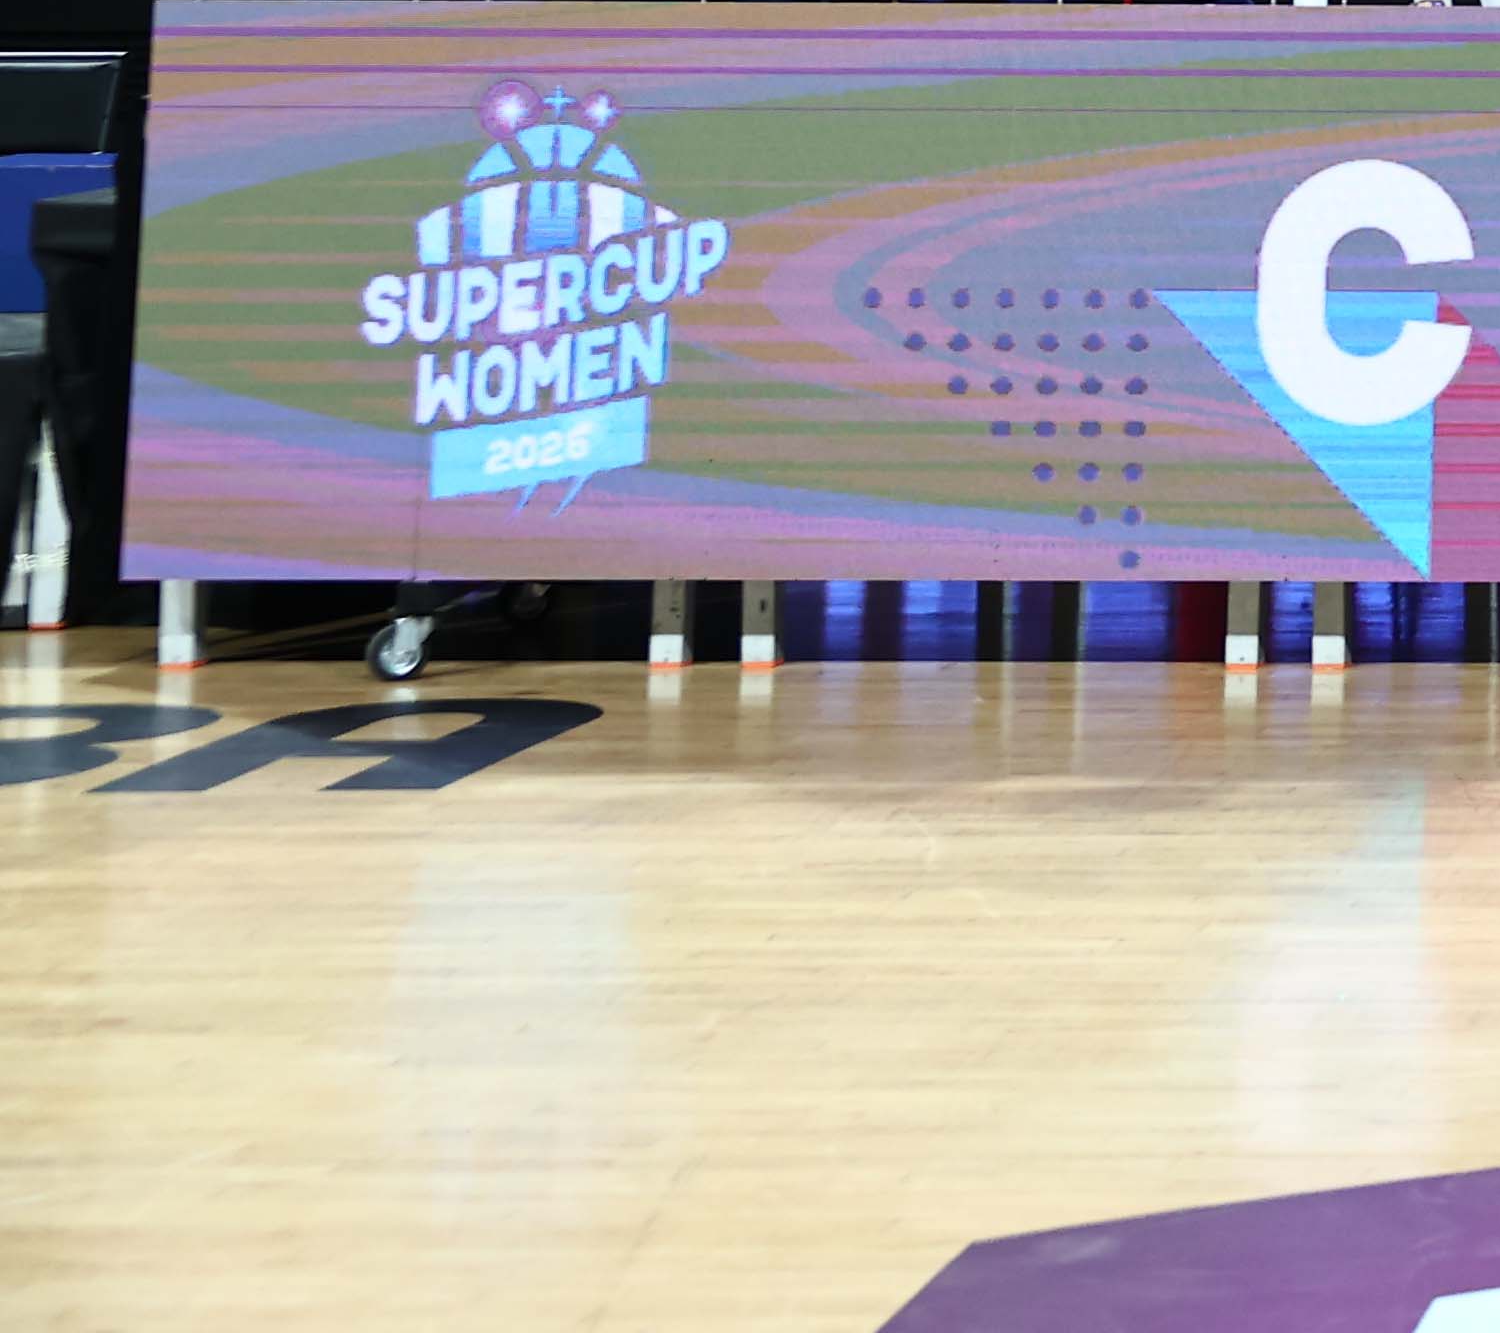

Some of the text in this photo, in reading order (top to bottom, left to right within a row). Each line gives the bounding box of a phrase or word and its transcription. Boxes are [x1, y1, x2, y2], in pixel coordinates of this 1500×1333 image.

[359, 219, 732, 347] SUPERCUP
[413, 314, 670, 427] WOMEN
[483, 418, 595, 474] 2026
